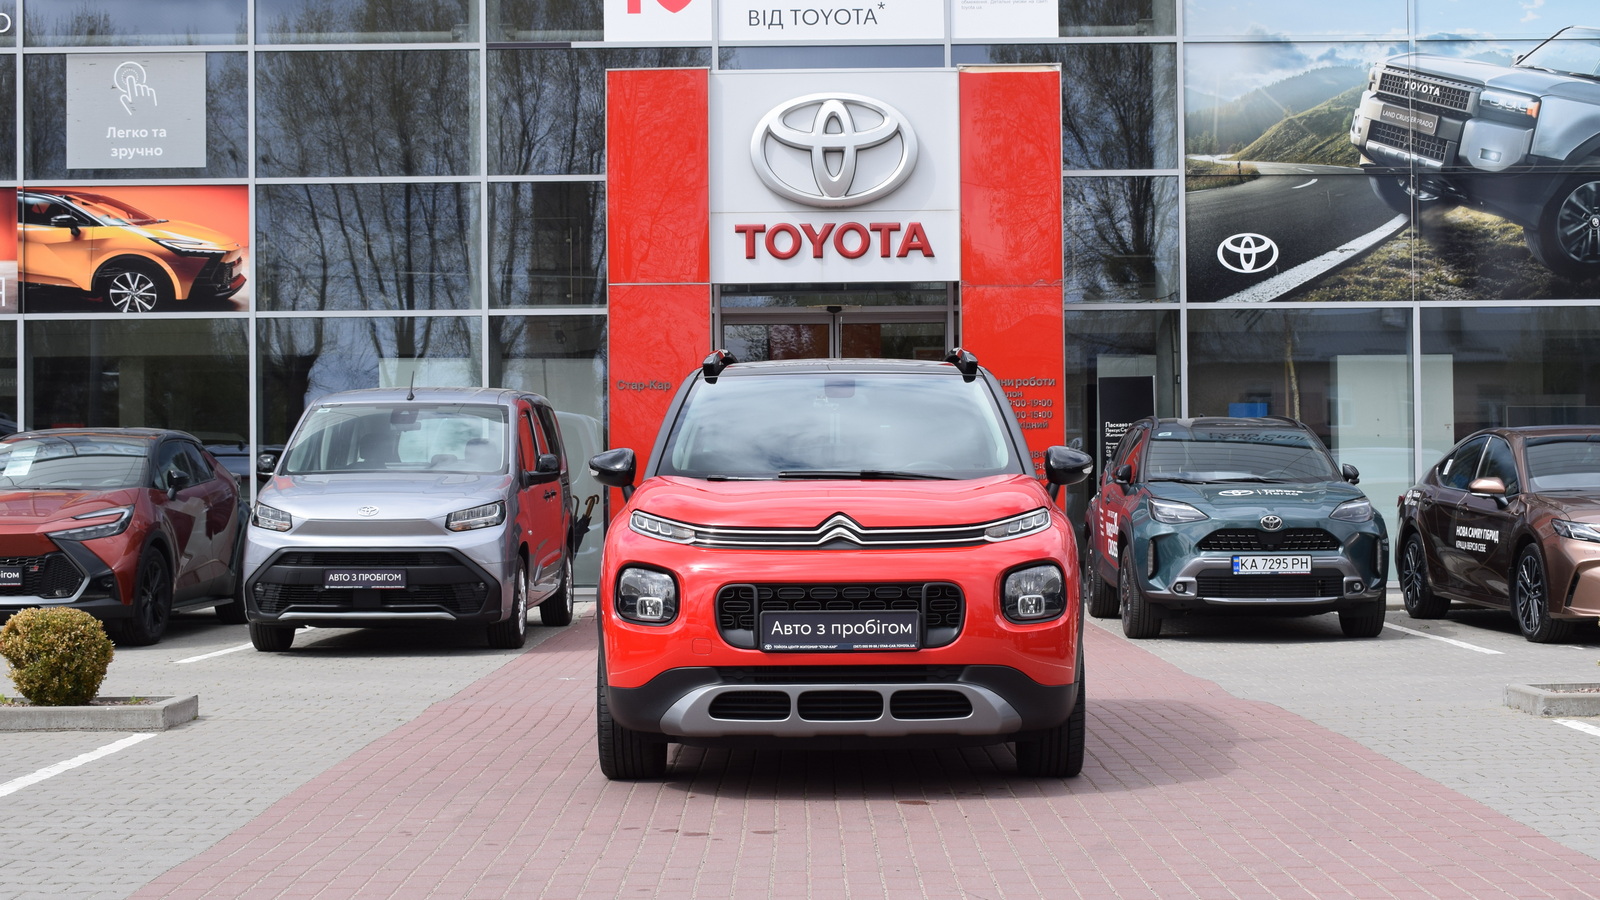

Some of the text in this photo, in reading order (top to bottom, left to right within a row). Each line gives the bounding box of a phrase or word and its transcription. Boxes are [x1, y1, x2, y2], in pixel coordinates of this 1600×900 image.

[749, 9, 784, 30] ВІД
[1404, 81, 1440, 96] TOYOTA
[1382, 110, 1434, 128] LAND CRUISER PRADO
[106, 127, 167, 140] Легко та
[110, 146, 163, 159] зручно
[734, 222, 936, 261] TOYOTA
[616, 379, 672, 392] Стар-Кар
[1015, 376, 1056, 388] роботи
[1016, 411, 1053, 419] 00-15:00
[1240, 558, 1308, 570] KA 7295 PH
[328, 573, 402, 581] АВТО З ПРОБІГОМ
[771, 619, 912, 638] Авто з пробігом
